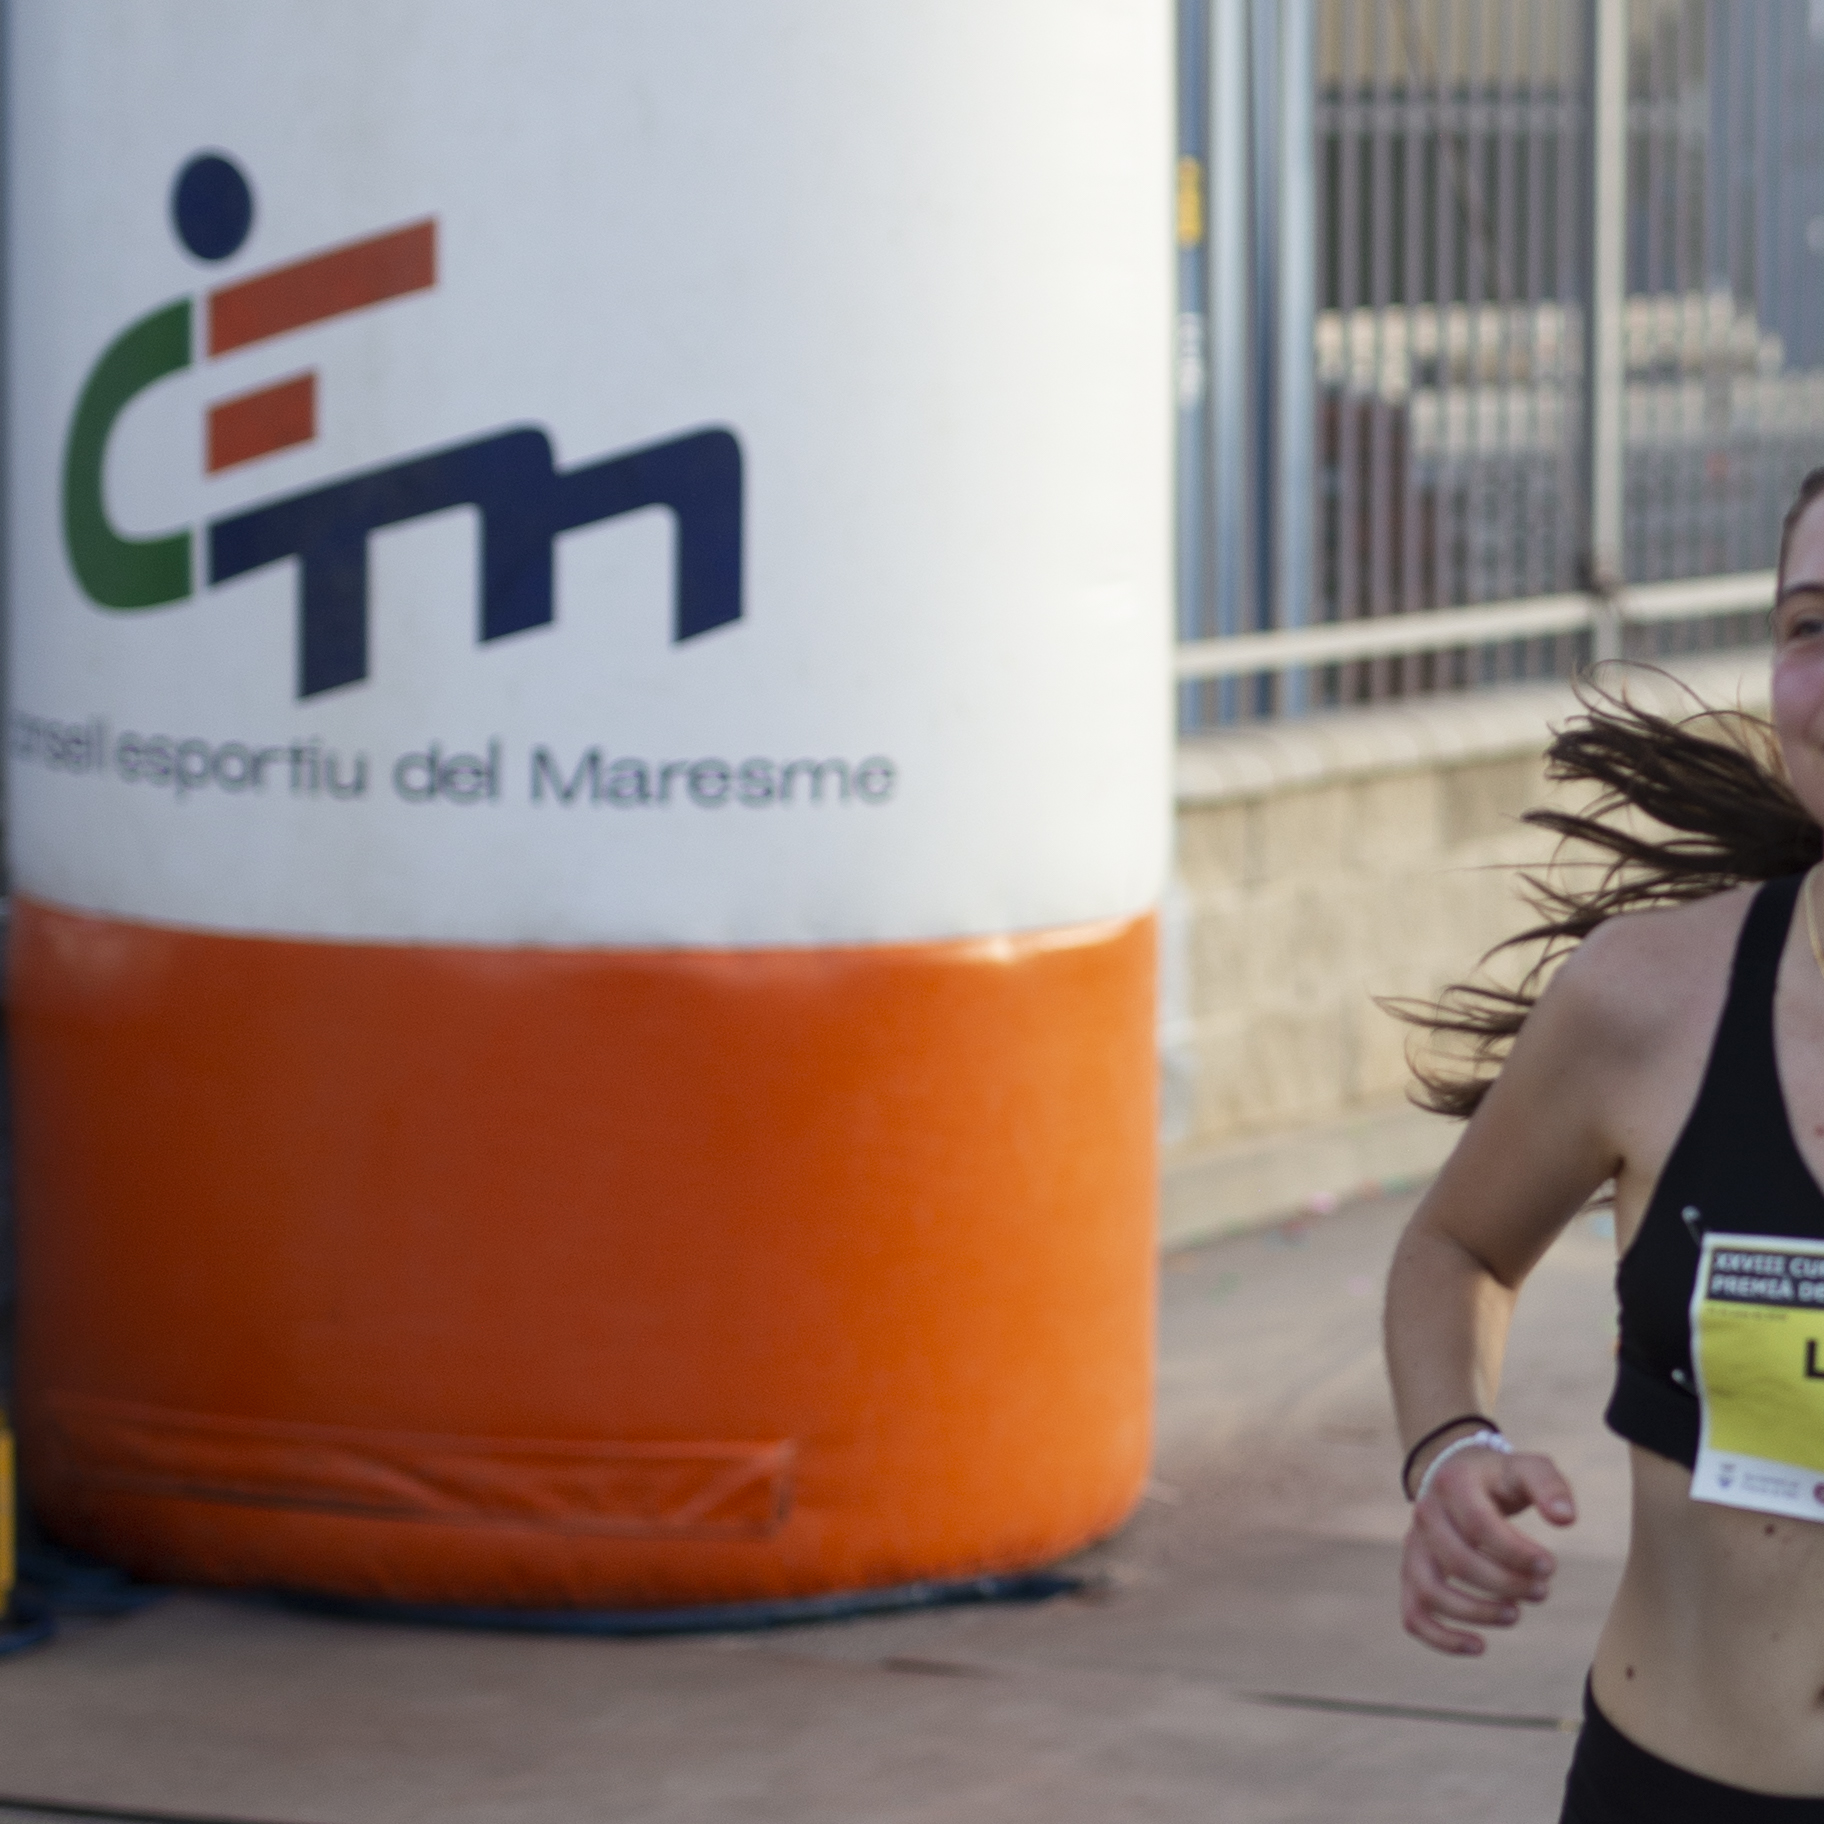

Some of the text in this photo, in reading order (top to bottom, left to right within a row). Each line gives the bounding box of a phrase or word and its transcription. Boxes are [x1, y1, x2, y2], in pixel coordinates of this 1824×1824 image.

[115, 728, 373, 808] esportiu
[391, 736, 505, 806] del
[527, 741, 899, 810] Maresme
